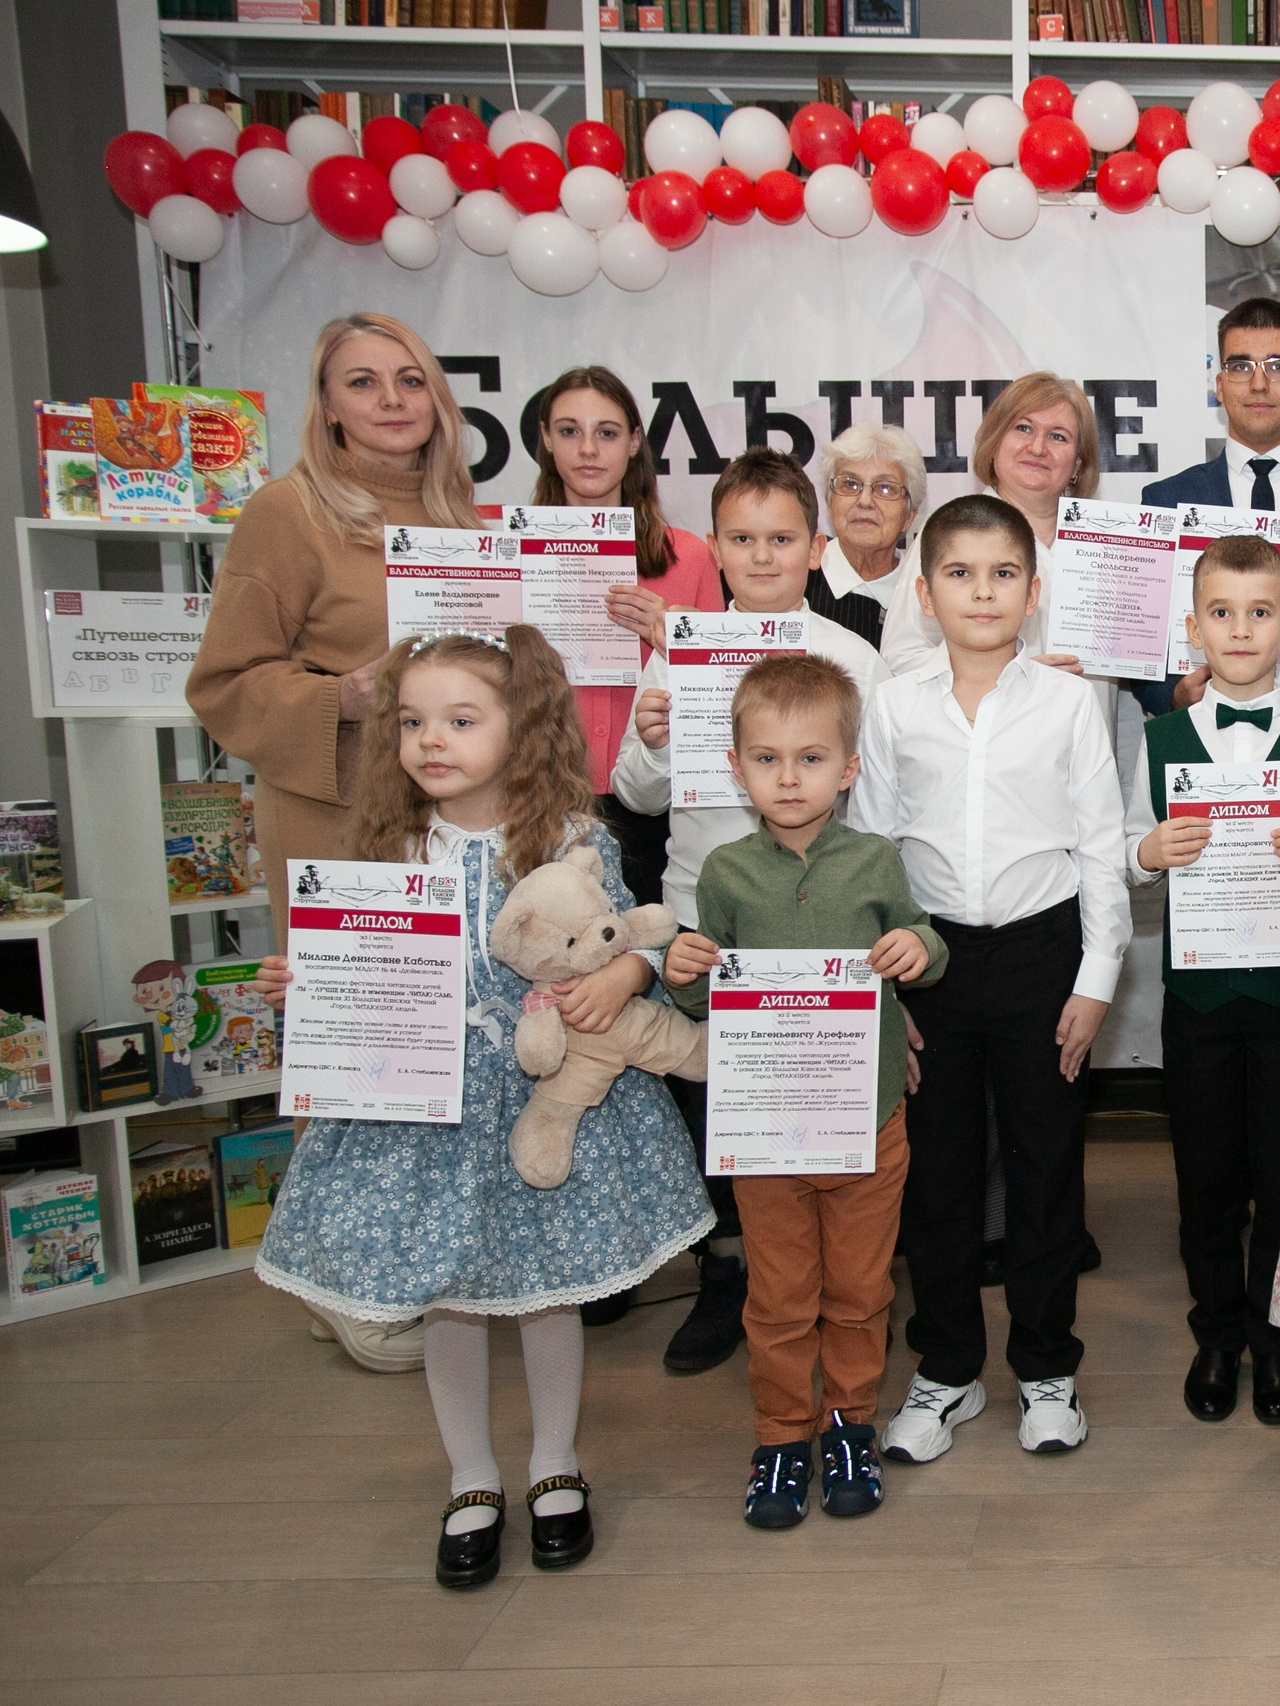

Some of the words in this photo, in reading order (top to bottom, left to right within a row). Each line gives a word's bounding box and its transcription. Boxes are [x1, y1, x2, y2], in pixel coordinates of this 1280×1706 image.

[601, 12, 611, 24] Ж
[646, 12, 656, 24] К
[1046, 20, 1056, 32] С
[190, 421, 224, 430] учшие
[443, 355, 1158, 484] БЛЬШЕ
[60, 429, 93, 438] НАРО
[71, 438, 94, 448] СКА
[191, 442, 236, 456] казки
[106, 470, 190, 494] Летучий
[116, 485, 182, 506] корабль
[591, 512, 605, 528] XI
[1138, 512, 1152, 527] XI
[1255, 517, 1268, 532] XI
[478, 536, 492, 552] XI
[544, 542, 598, 553] ДИПЛОМ
[1064, 532, 1137, 545] БЛАГОДАРСТВЕННОЕ
[1137, 539, 1169, 548] ПИСЬМО
[1075, 548, 1101, 557] Юлии
[1103, 551, 1155, 563] Валерьевне
[389, 567, 480, 577] БЛАГОДАРСТВЕННОЕ
[482, 570, 518, 578] ПИСЬМО
[537, 568, 586, 576] Дмитриевне
[1090, 561, 1139, 572] Смольских
[441, 590, 499, 598] Владимировне
[75, 628, 202, 643] «Путешестви
[760, 620, 775, 636] XI
[72, 651, 139, 661] сквозь
[63, 671, 84, 687] А
[89, 675, 109, 692] Б
[122, 669, 138, 683] В
[152, 673, 171, 693] Г
[1262, 769, 1277, 787] XI
[1208, 804, 1269, 817] ДИПЛОМ
[405, 874, 423, 895] XI
[340, 914, 412, 929] ДИПЛОМ
[297, 951, 340, 961] Милане
[342, 954, 401, 964] Денисовне
[403, 956, 451, 966] Каботько
[823, 957, 841, 976] XI
[759, 995, 828, 1007] ДИПЛОМ
[719, 1030, 748, 1039] Егору
[751, 1030, 813, 1039] Евгеньевичу
[816, 1030, 865, 1039] Арефьеву
[56, 1180, 94, 1191] ДЕТСКОЕ
[59, 1186, 92, 1195] ЧТЕНИЕ
[31, 1204, 83, 1220] СТАРИК
[22, 1210, 95, 1231] ХОТТАБЫЧ
[153, 1229, 179, 1241] ЗОРИ
[181, 1222, 212, 1235] ЗДЕСЬ
[528, 1476, 581, 1502] OUTIQU
